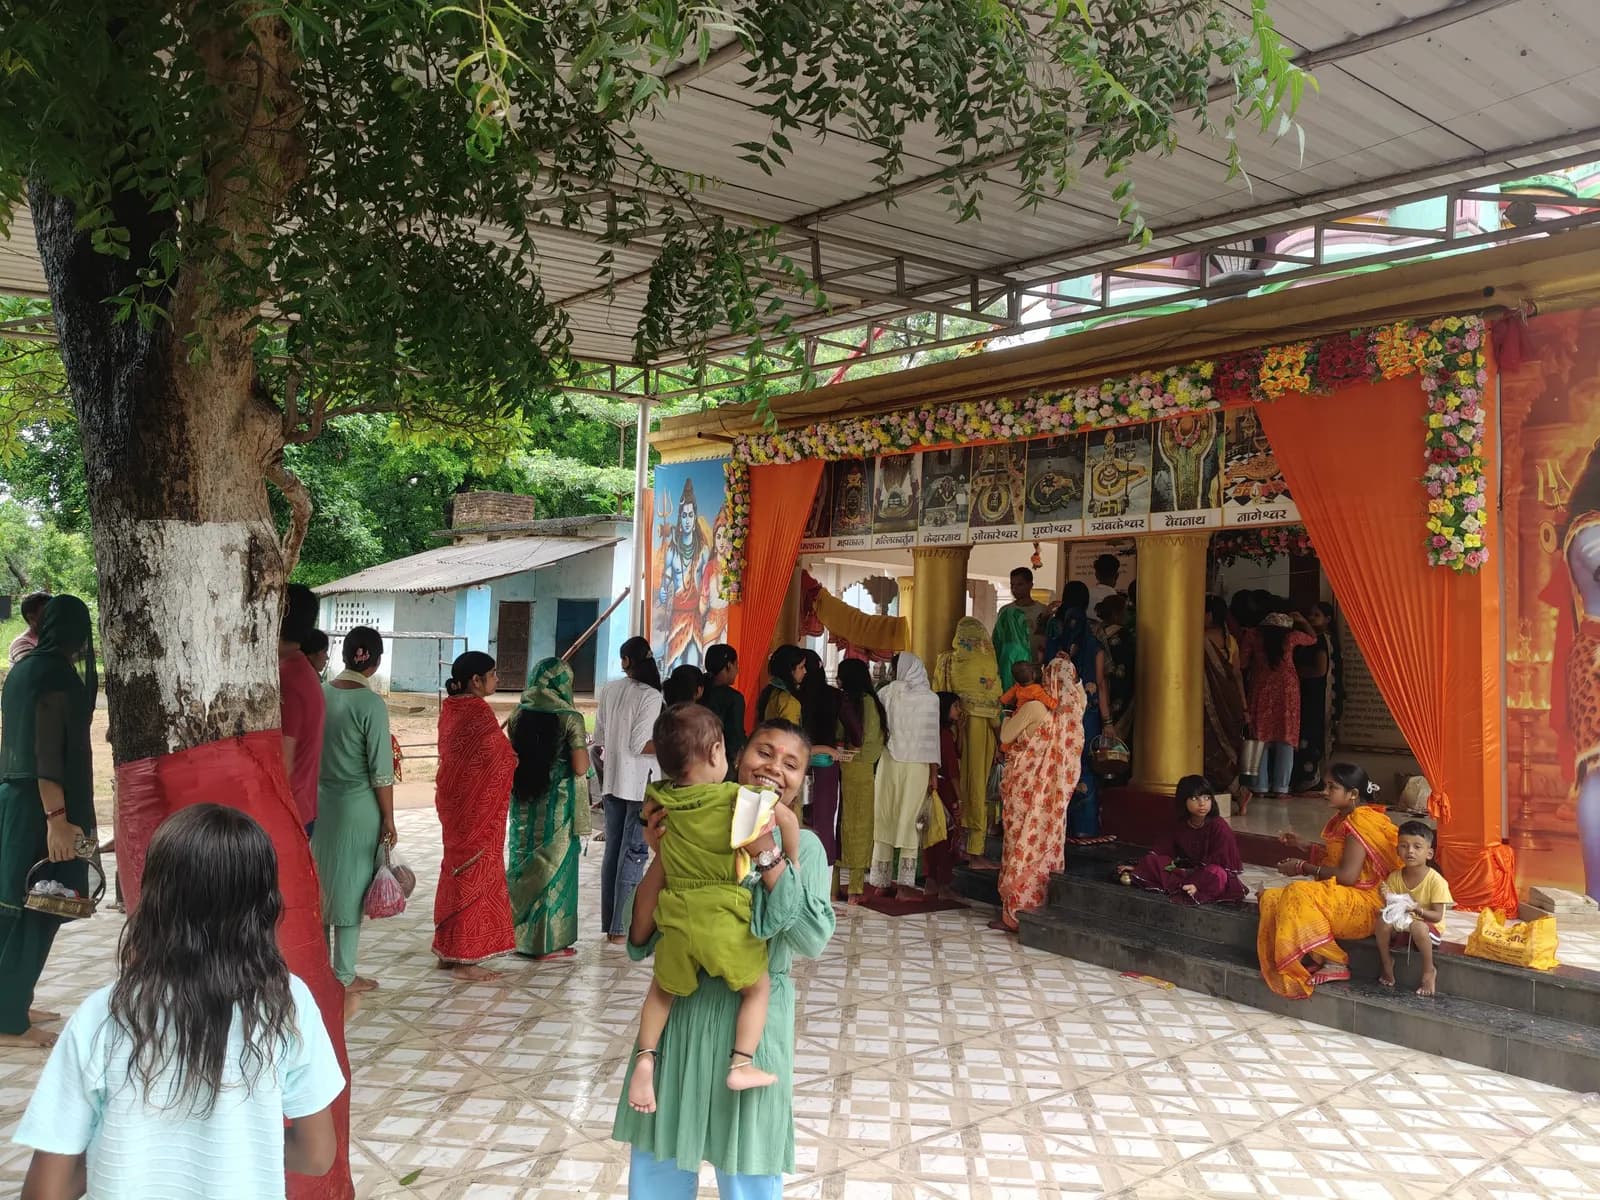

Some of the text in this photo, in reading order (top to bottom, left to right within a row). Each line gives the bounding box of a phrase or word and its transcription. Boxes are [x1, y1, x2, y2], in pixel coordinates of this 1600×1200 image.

[1164, 515, 1206, 527] वैद्यनाथ
[1237, 507, 1288, 523] नागेश्वर
[923, 532, 961, 543] केदारनाथ
